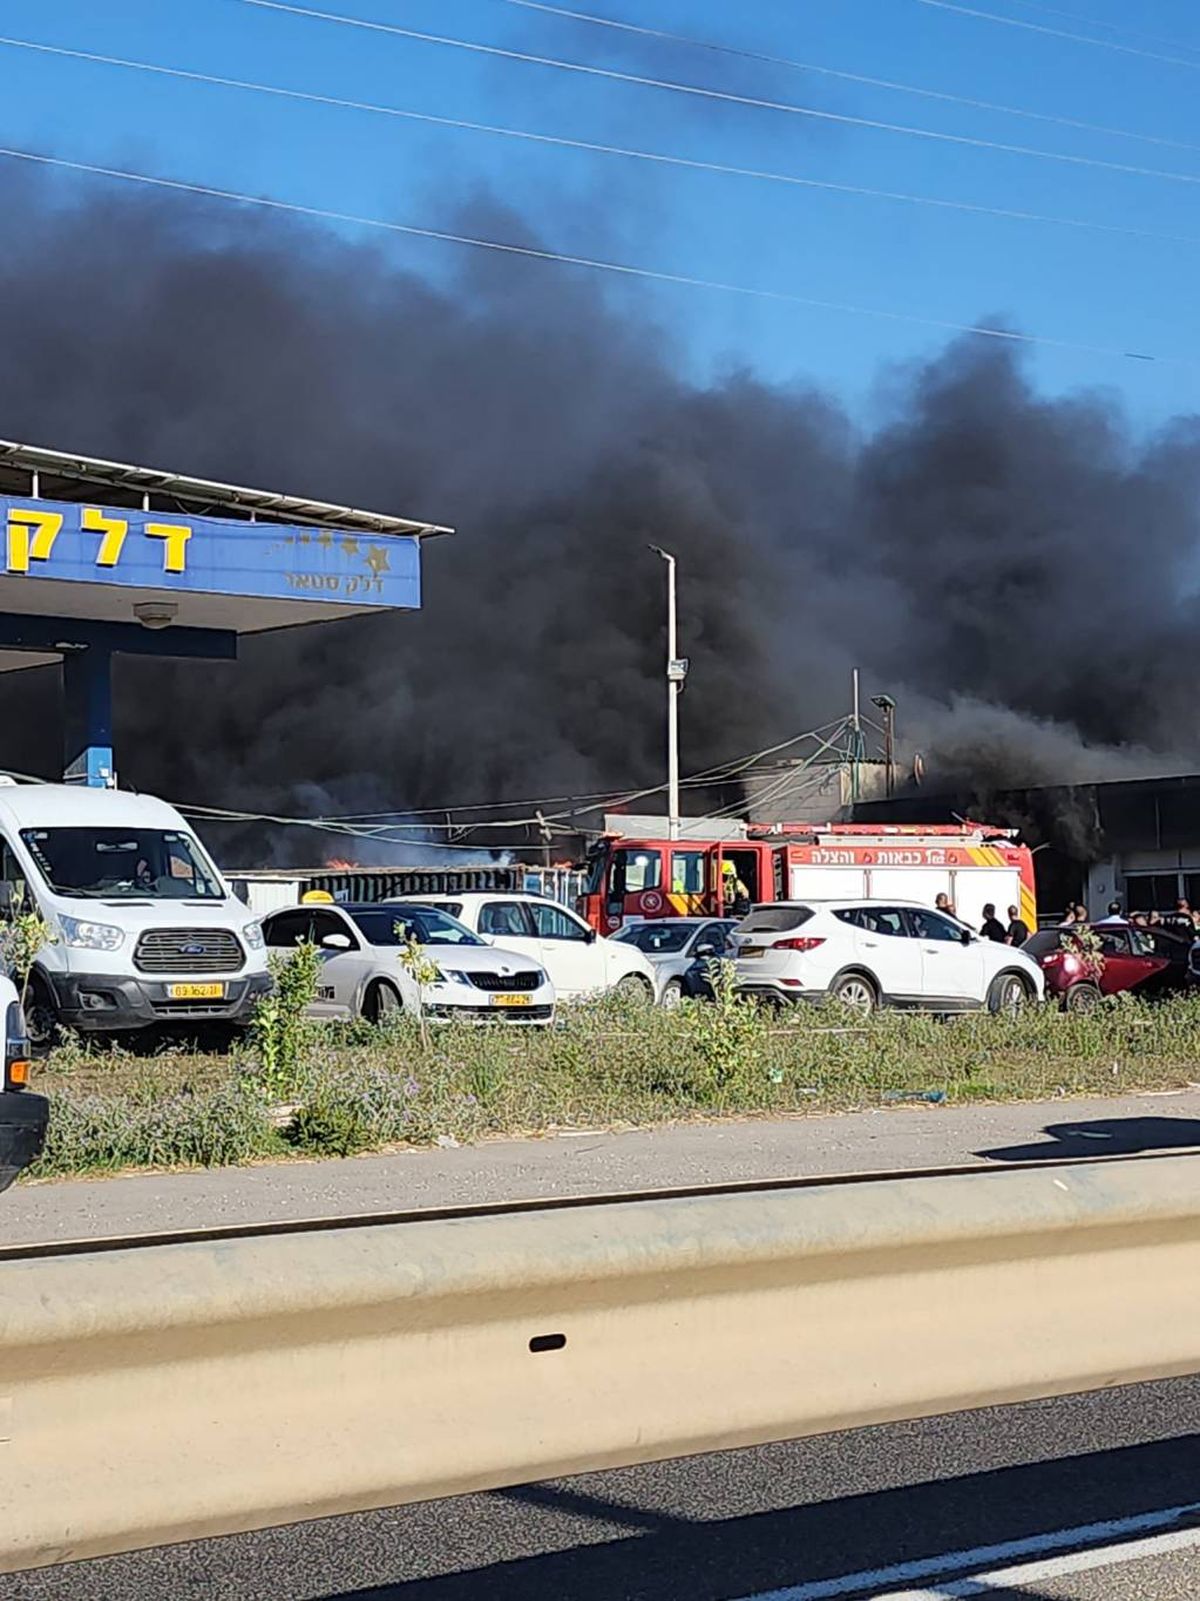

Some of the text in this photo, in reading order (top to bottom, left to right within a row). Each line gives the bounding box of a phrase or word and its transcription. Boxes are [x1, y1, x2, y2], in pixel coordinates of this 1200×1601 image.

[7, 508, 192, 573] דלק
[345, 574, 384, 594] דלק
[811, 849, 855, 864] והצלה
[877, 851, 921, 864] כבאות
